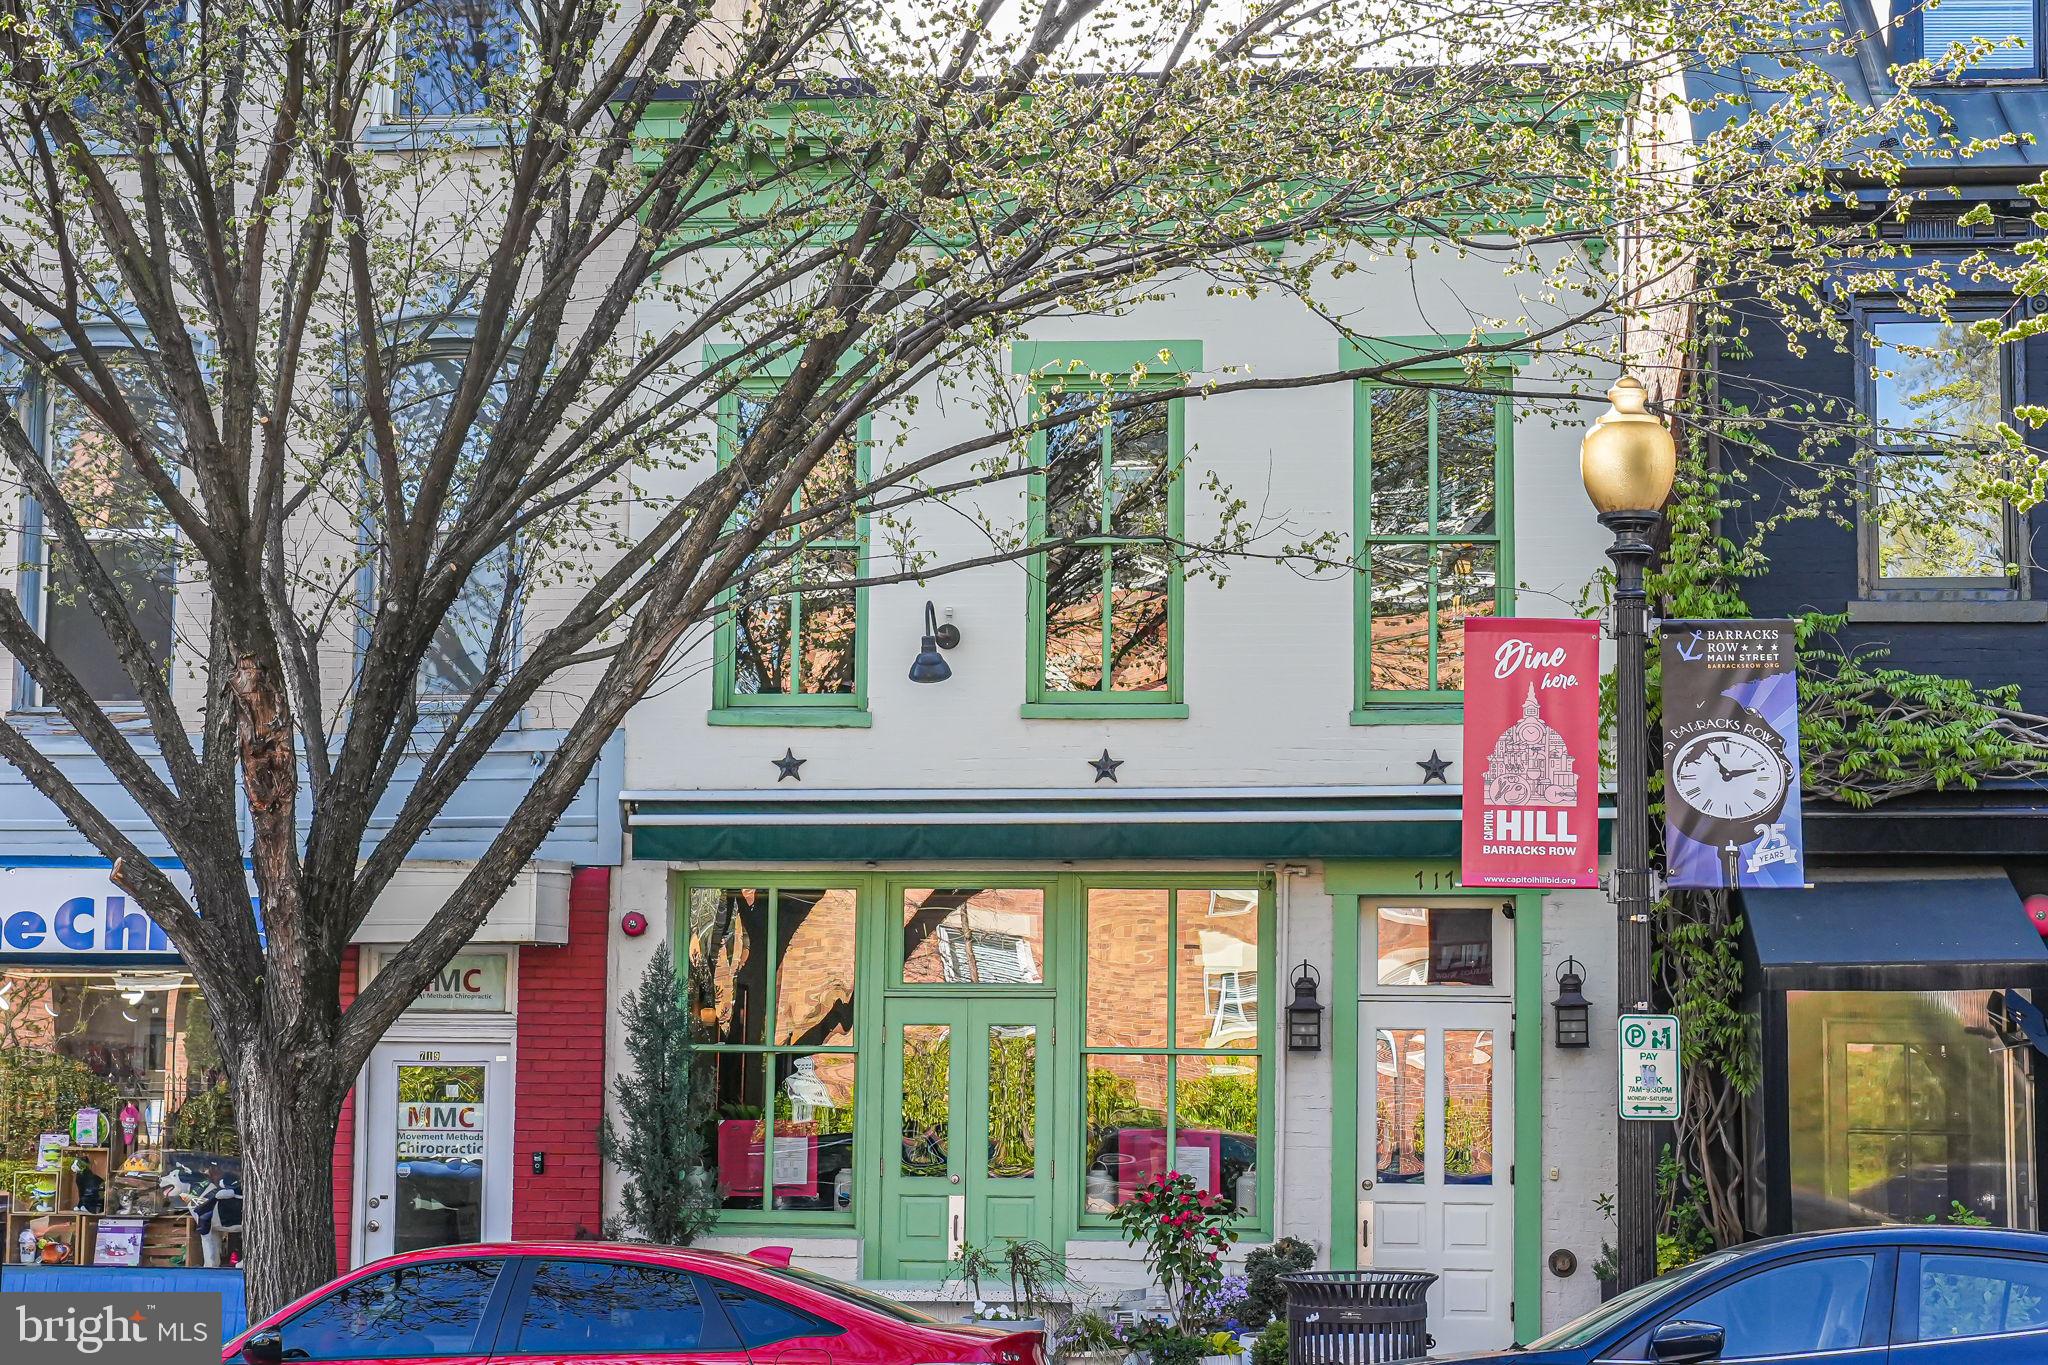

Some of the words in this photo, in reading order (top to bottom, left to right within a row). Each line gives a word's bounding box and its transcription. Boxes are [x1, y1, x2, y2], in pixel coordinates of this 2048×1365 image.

[1707, 629, 1779, 640] BARRACKS
[1707, 642, 1739, 653] ROW
[1494, 639, 1567, 679] Dine
[1707, 654, 1735, 662] MAIN
[1739, 653, 1780, 661] STREET
[1541, 672, 1579, 690] here.
[1743, 723, 1775, 742] ROW
[1484, 810, 1494, 841] CAPITOL
[1496, 810, 1578, 842] HILL
[1753, 823, 1788, 851] 25
[1482, 845, 1546, 856] BARRACKS
[1548, 846, 1577, 856] ROW
[1759, 850, 1784, 862] YEARS
[1484, 876, 1576, 885] www.capitolhillbid.org
[0, 910, 47, 950] e
[419, 1051, 440, 1060] 719
[408, 1107, 475, 1128] MMC
[446, 1133, 483, 1141] Methods
[398, 1142, 483, 1155] Chiropractic
